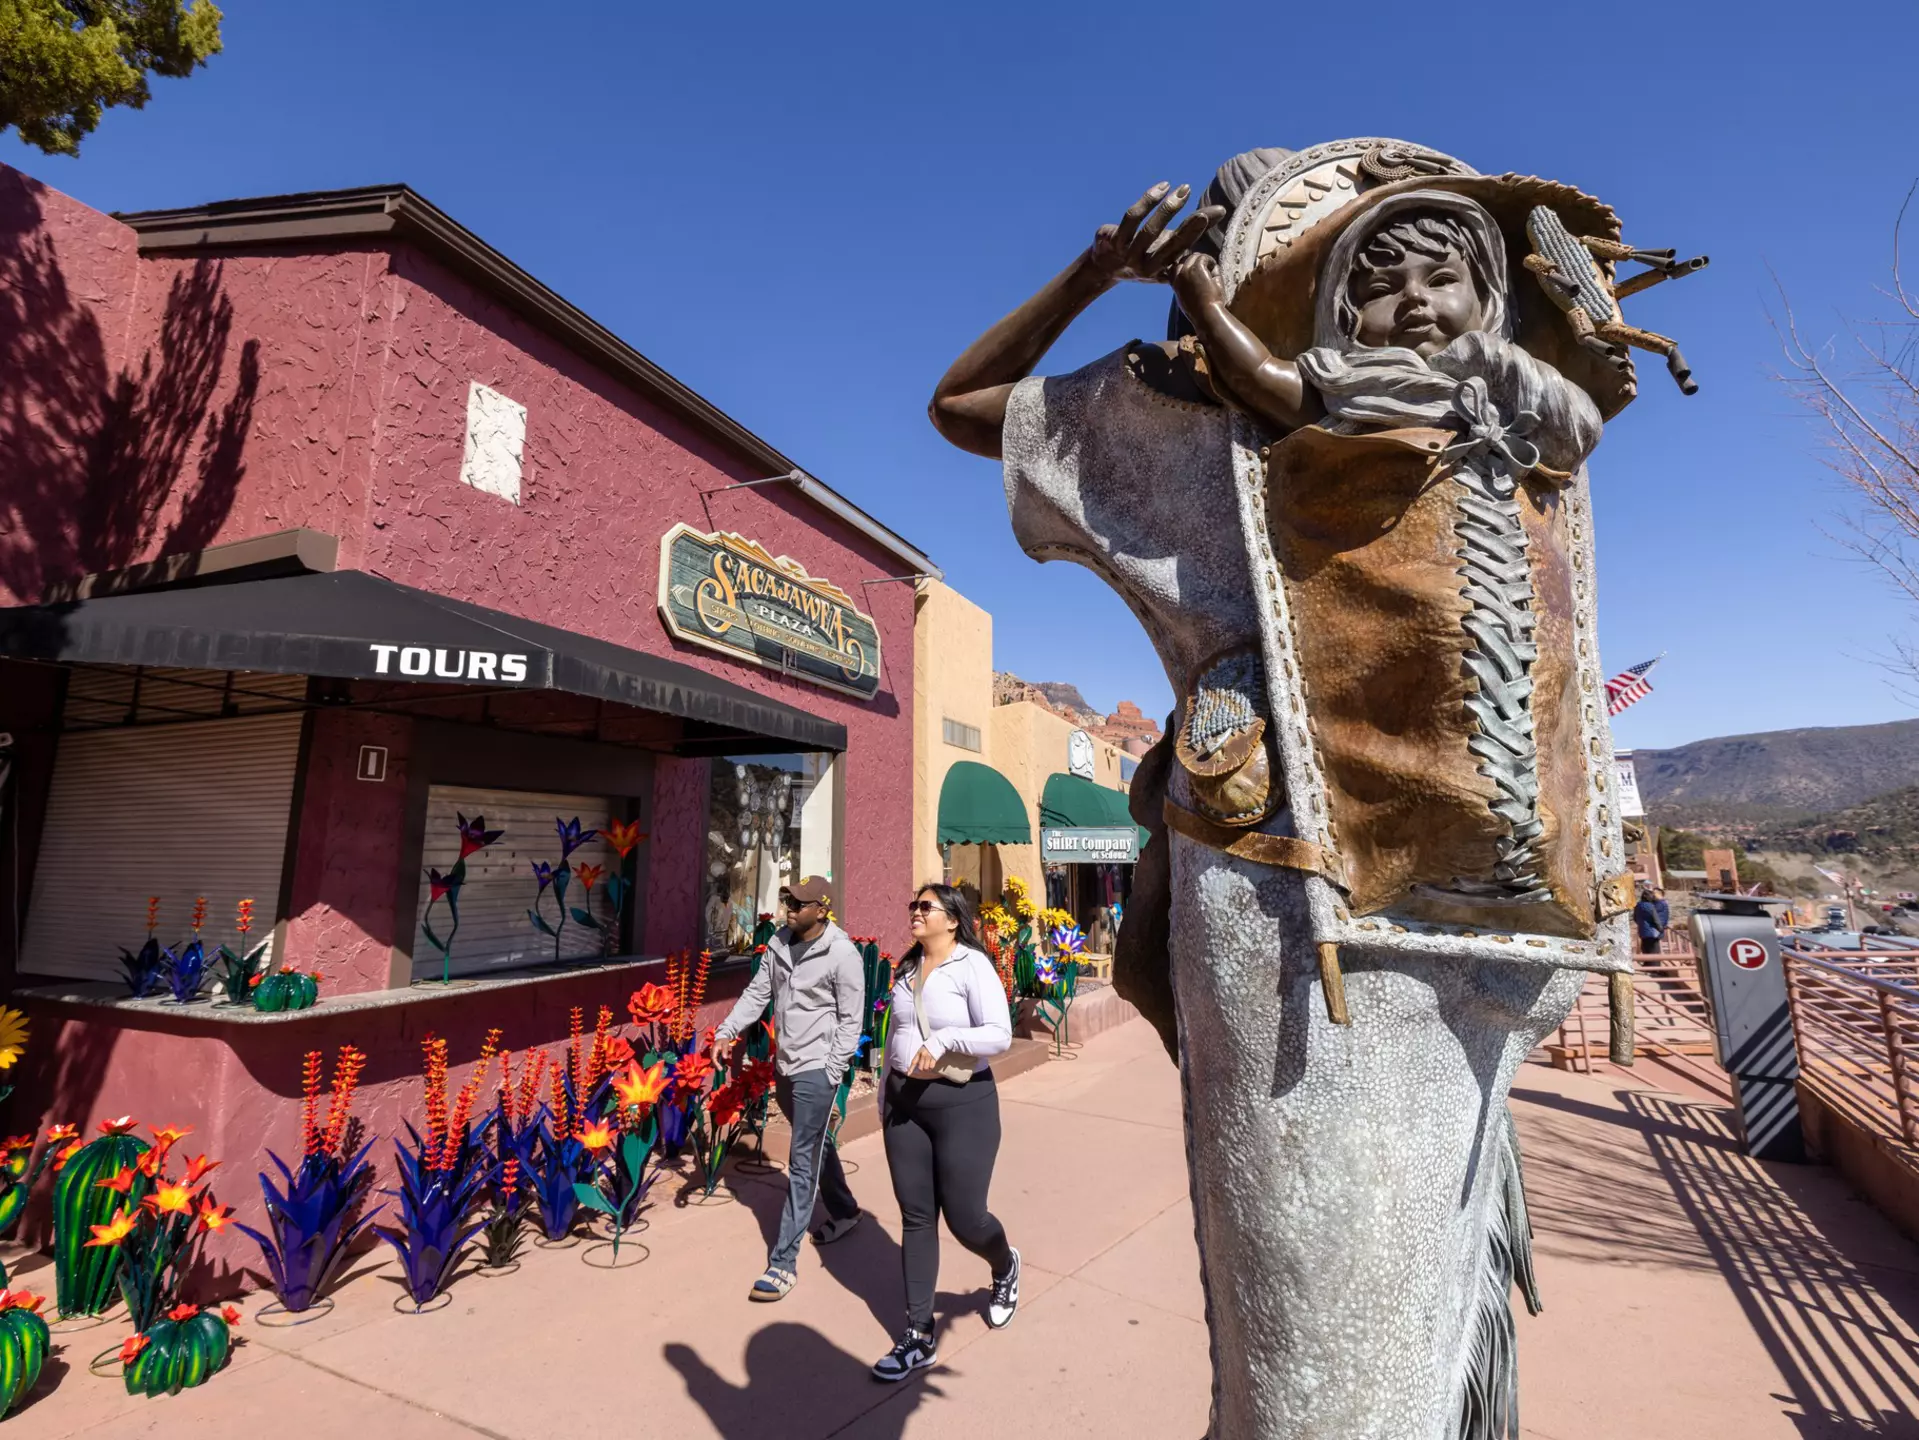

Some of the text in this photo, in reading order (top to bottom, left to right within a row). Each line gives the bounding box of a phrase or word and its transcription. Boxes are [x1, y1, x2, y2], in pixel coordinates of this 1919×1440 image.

[697, 551, 864, 680] SACAJAWEA
[759, 604, 812, 639] PLAZA
[369, 644, 528, 682] TOURS
[1047, 837, 1132, 853] SHIRT Company
[1092, 851, 1128, 860] of Sedona
[1736, 944, 1762, 964] P
